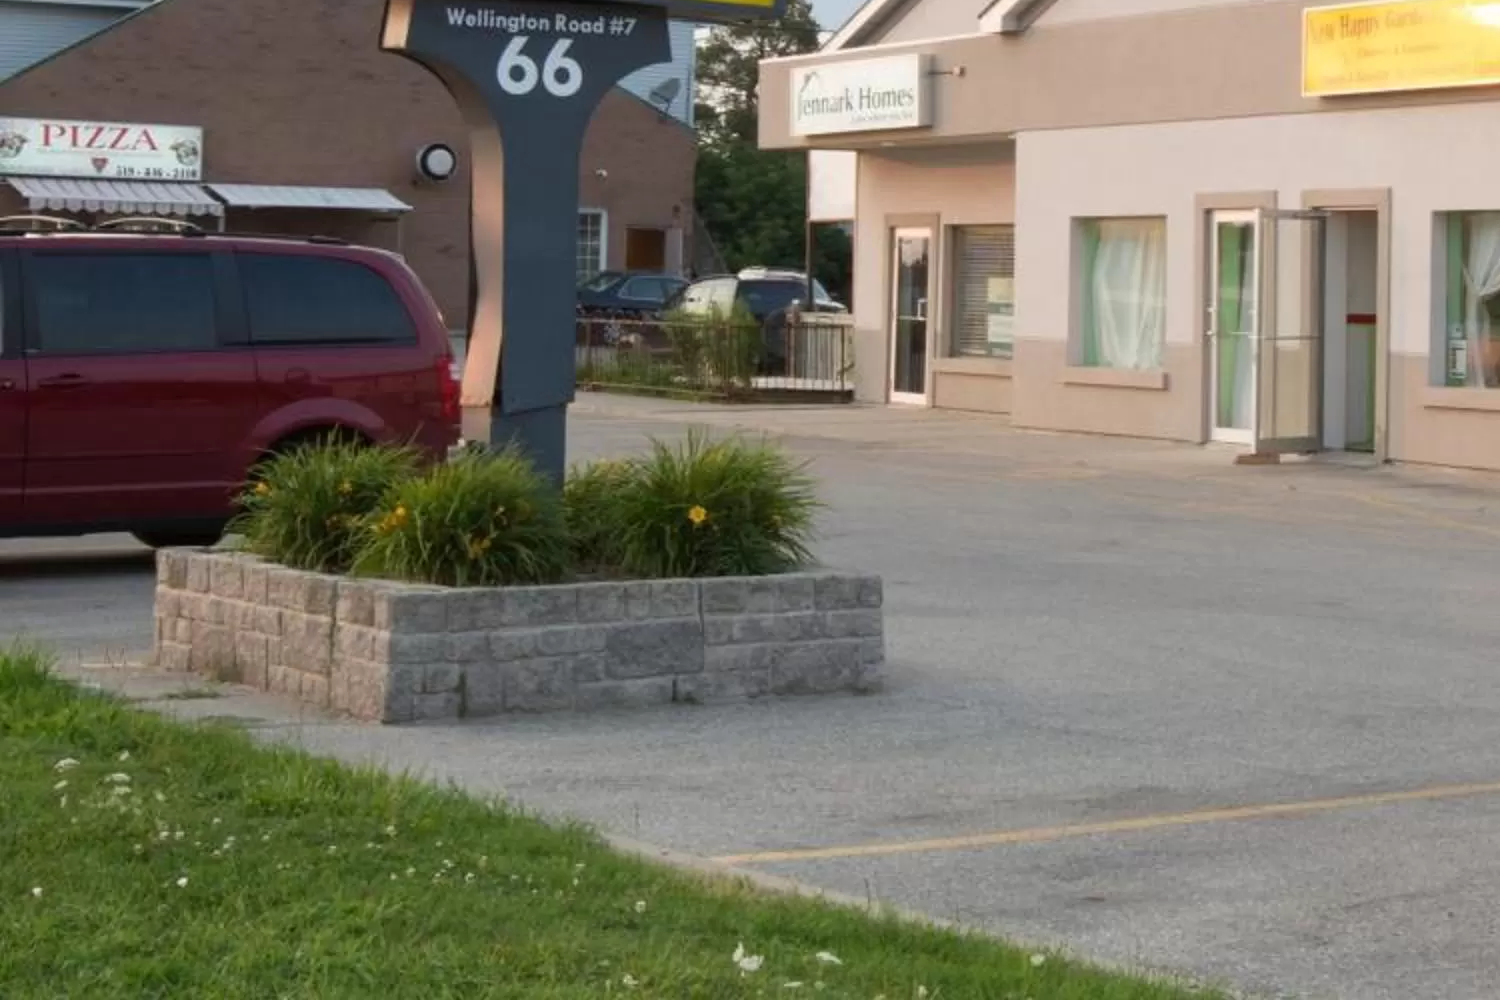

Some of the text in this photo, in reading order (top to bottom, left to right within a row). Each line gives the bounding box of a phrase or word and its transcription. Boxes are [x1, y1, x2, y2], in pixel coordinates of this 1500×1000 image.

[446, 7, 637, 37] Wellington Road #7
[496, 35, 583, 97] 66
[859, 85, 914, 110] Homes
[41, 123, 159, 150] PIZZA
